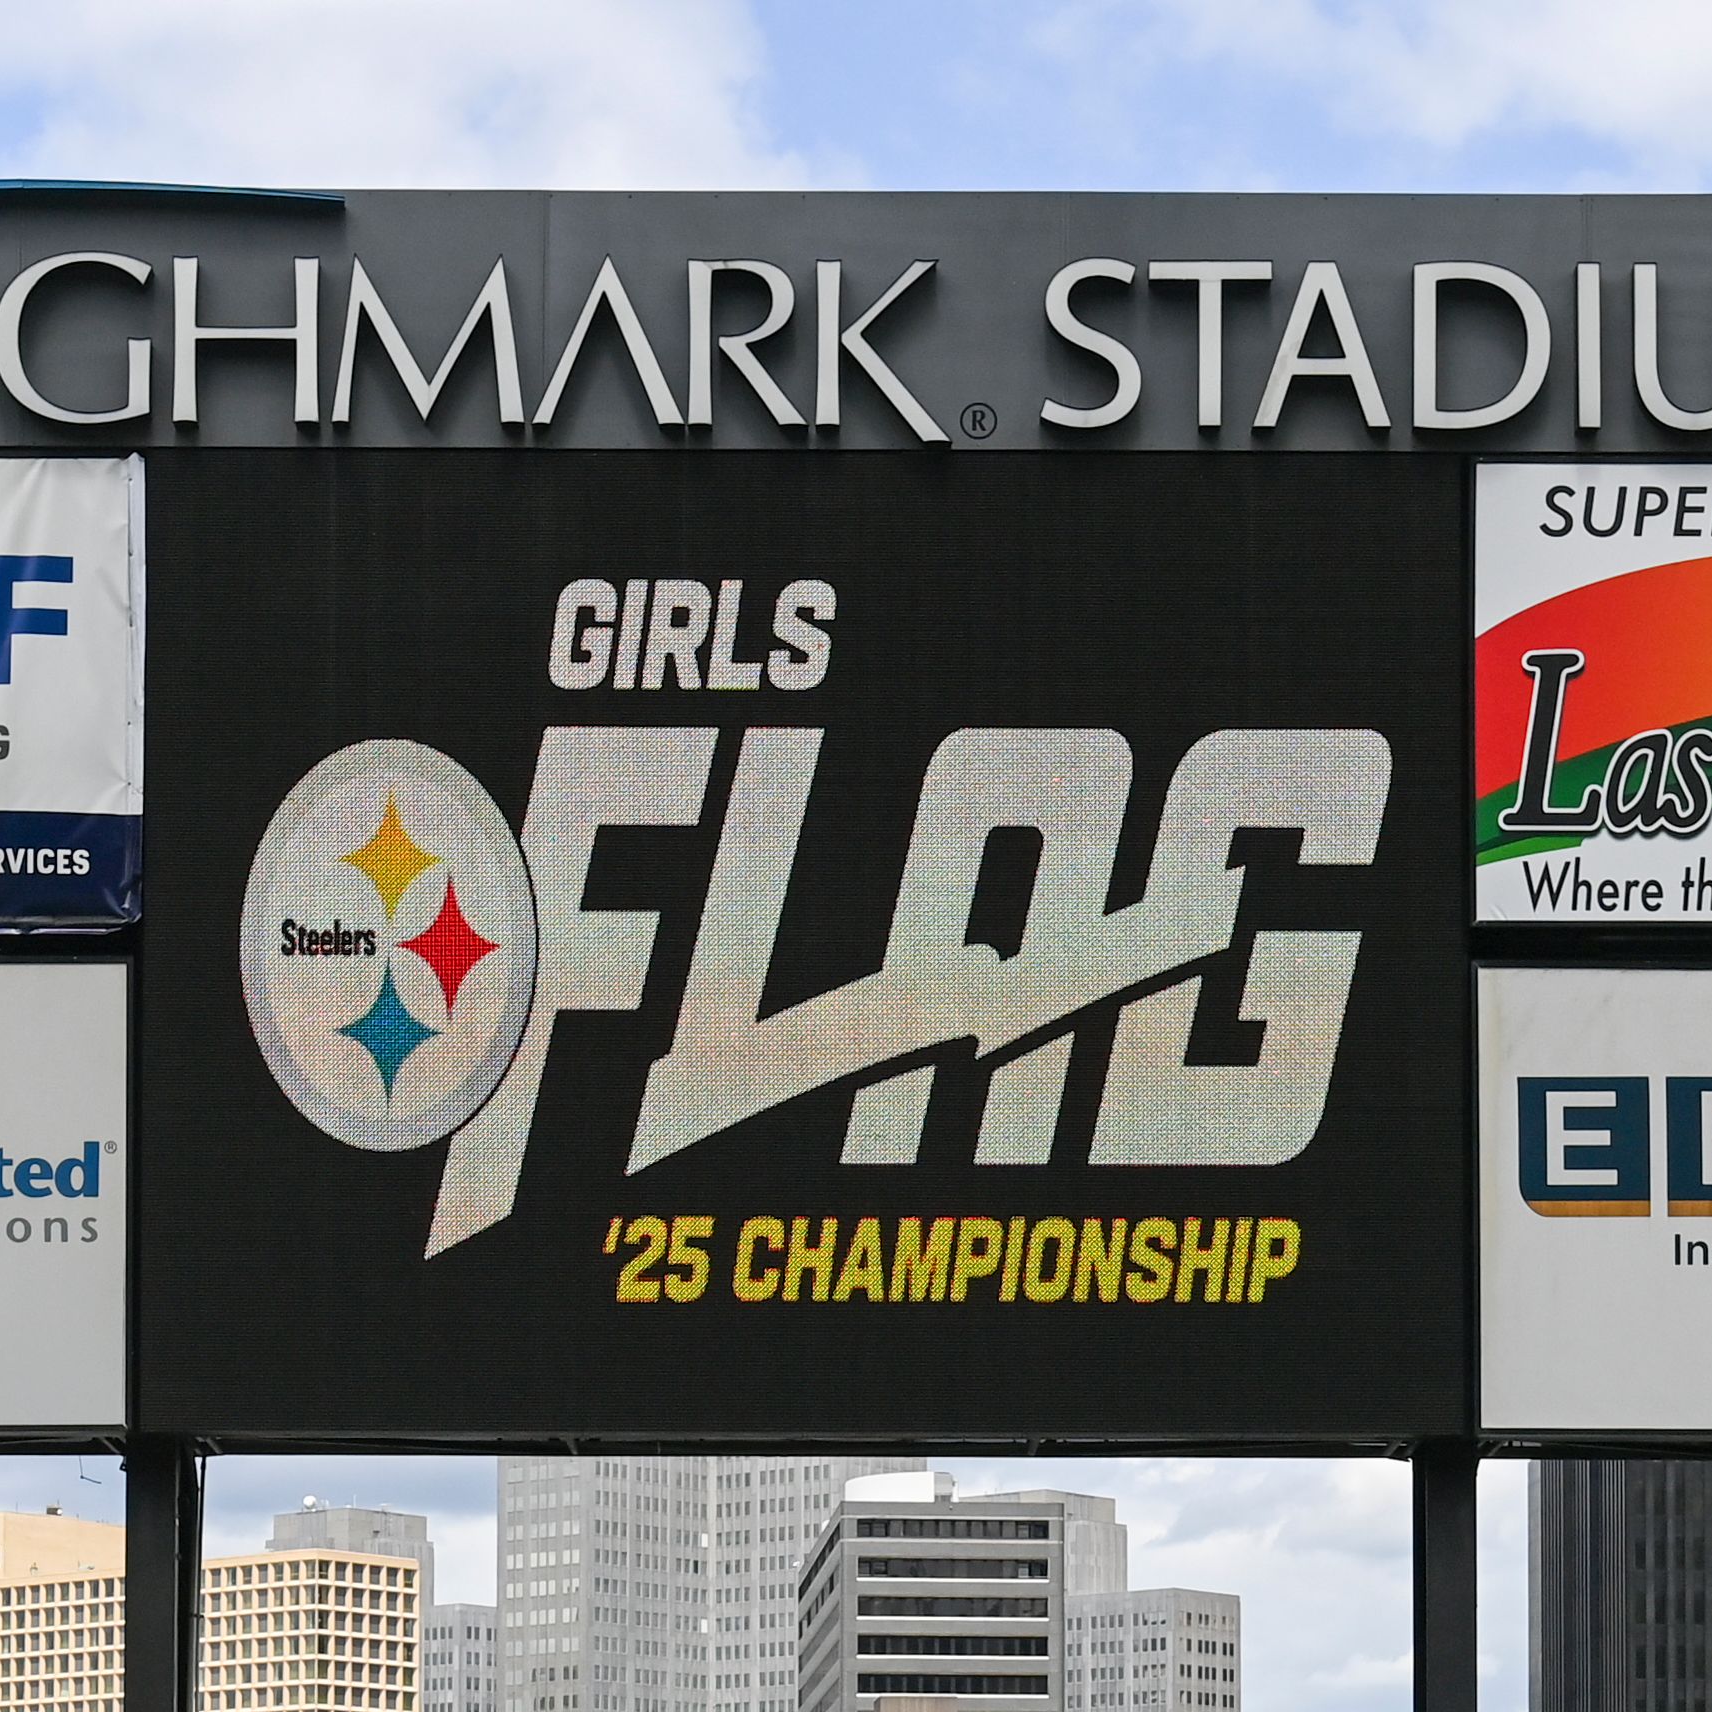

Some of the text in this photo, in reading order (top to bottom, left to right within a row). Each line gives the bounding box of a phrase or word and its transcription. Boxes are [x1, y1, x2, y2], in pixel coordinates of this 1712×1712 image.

[548, 579, 837, 690] GIRLS
[1523, 859, 1663, 914] Where
[280, 919, 376, 959] Steelers
[425, 727, 1392, 1260] FLAG
[733, 1216, 1300, 1303] CHAMPIONSHIP
